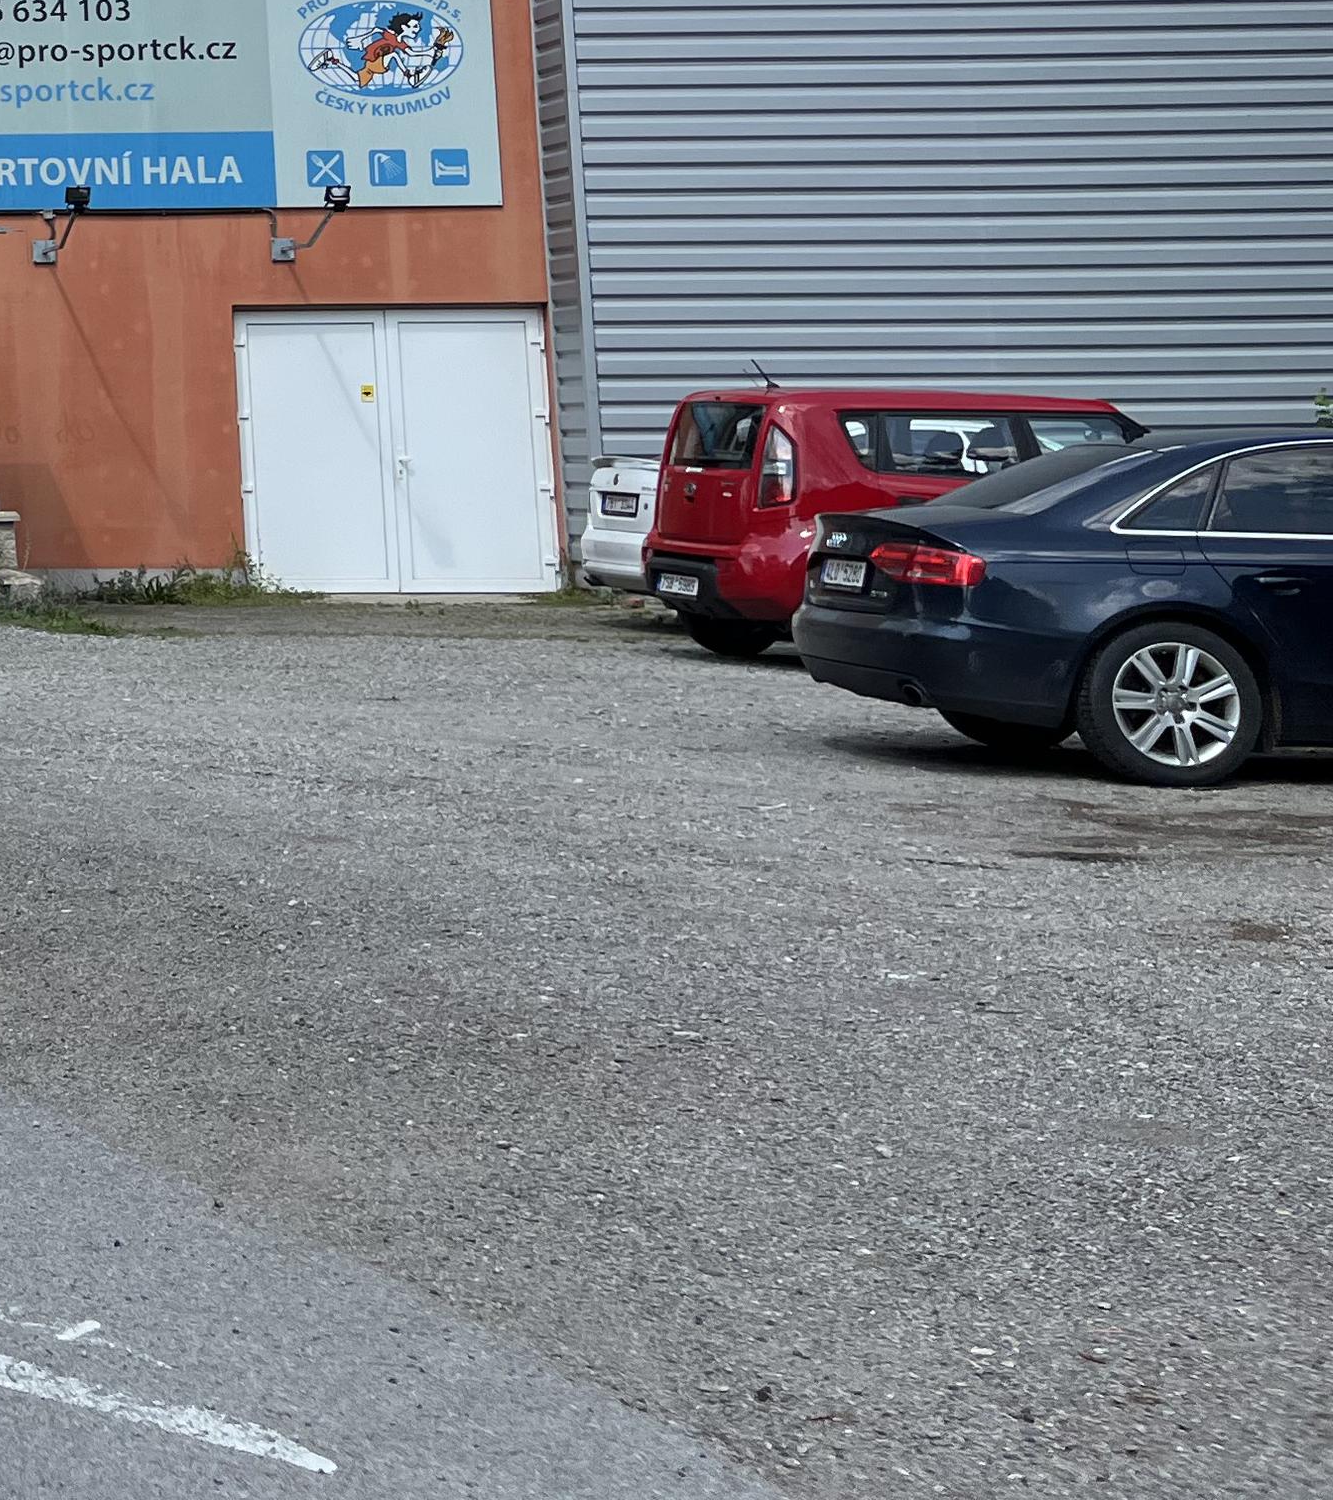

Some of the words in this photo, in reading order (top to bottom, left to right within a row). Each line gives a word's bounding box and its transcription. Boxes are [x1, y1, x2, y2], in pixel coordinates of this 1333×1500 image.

[13, 0, 67, 23] 634
[314, 87, 366, 116] ČESKÝ
[372, 86, 451, 116] KRUMLOV
[142, 155, 243, 185] HALA
